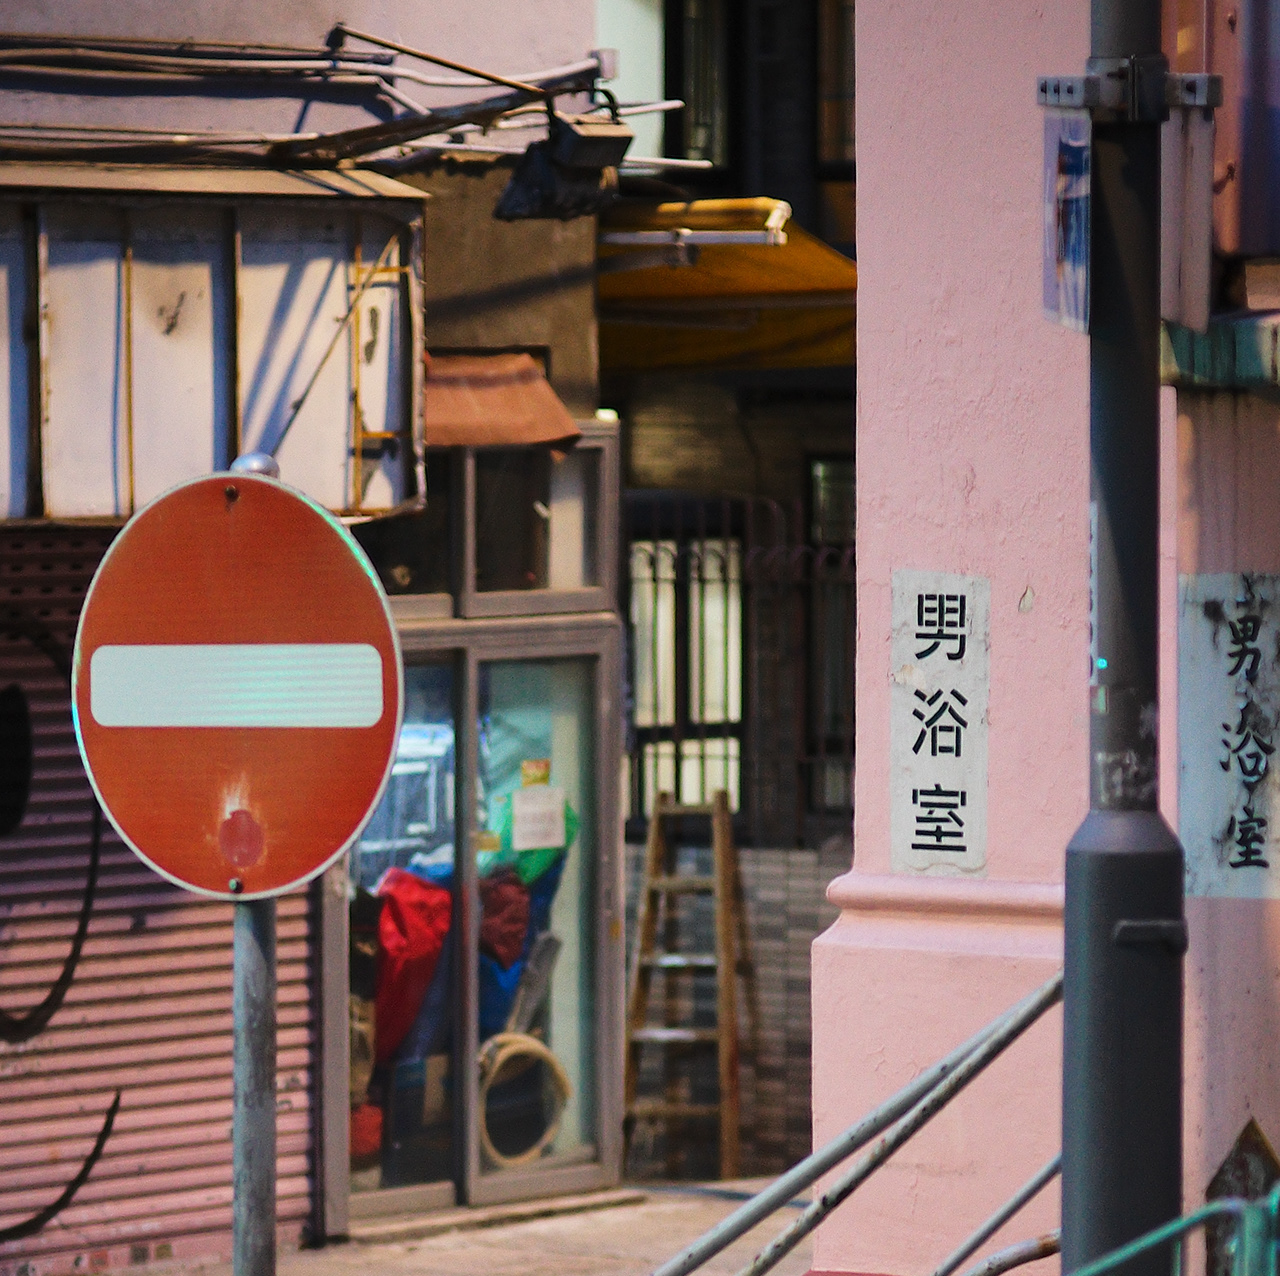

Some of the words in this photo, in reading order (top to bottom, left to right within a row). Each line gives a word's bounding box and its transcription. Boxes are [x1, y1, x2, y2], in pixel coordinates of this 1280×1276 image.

[911, 593, 969, 853] 男浴室
[1220, 614, 1276, 869] 男浴室
